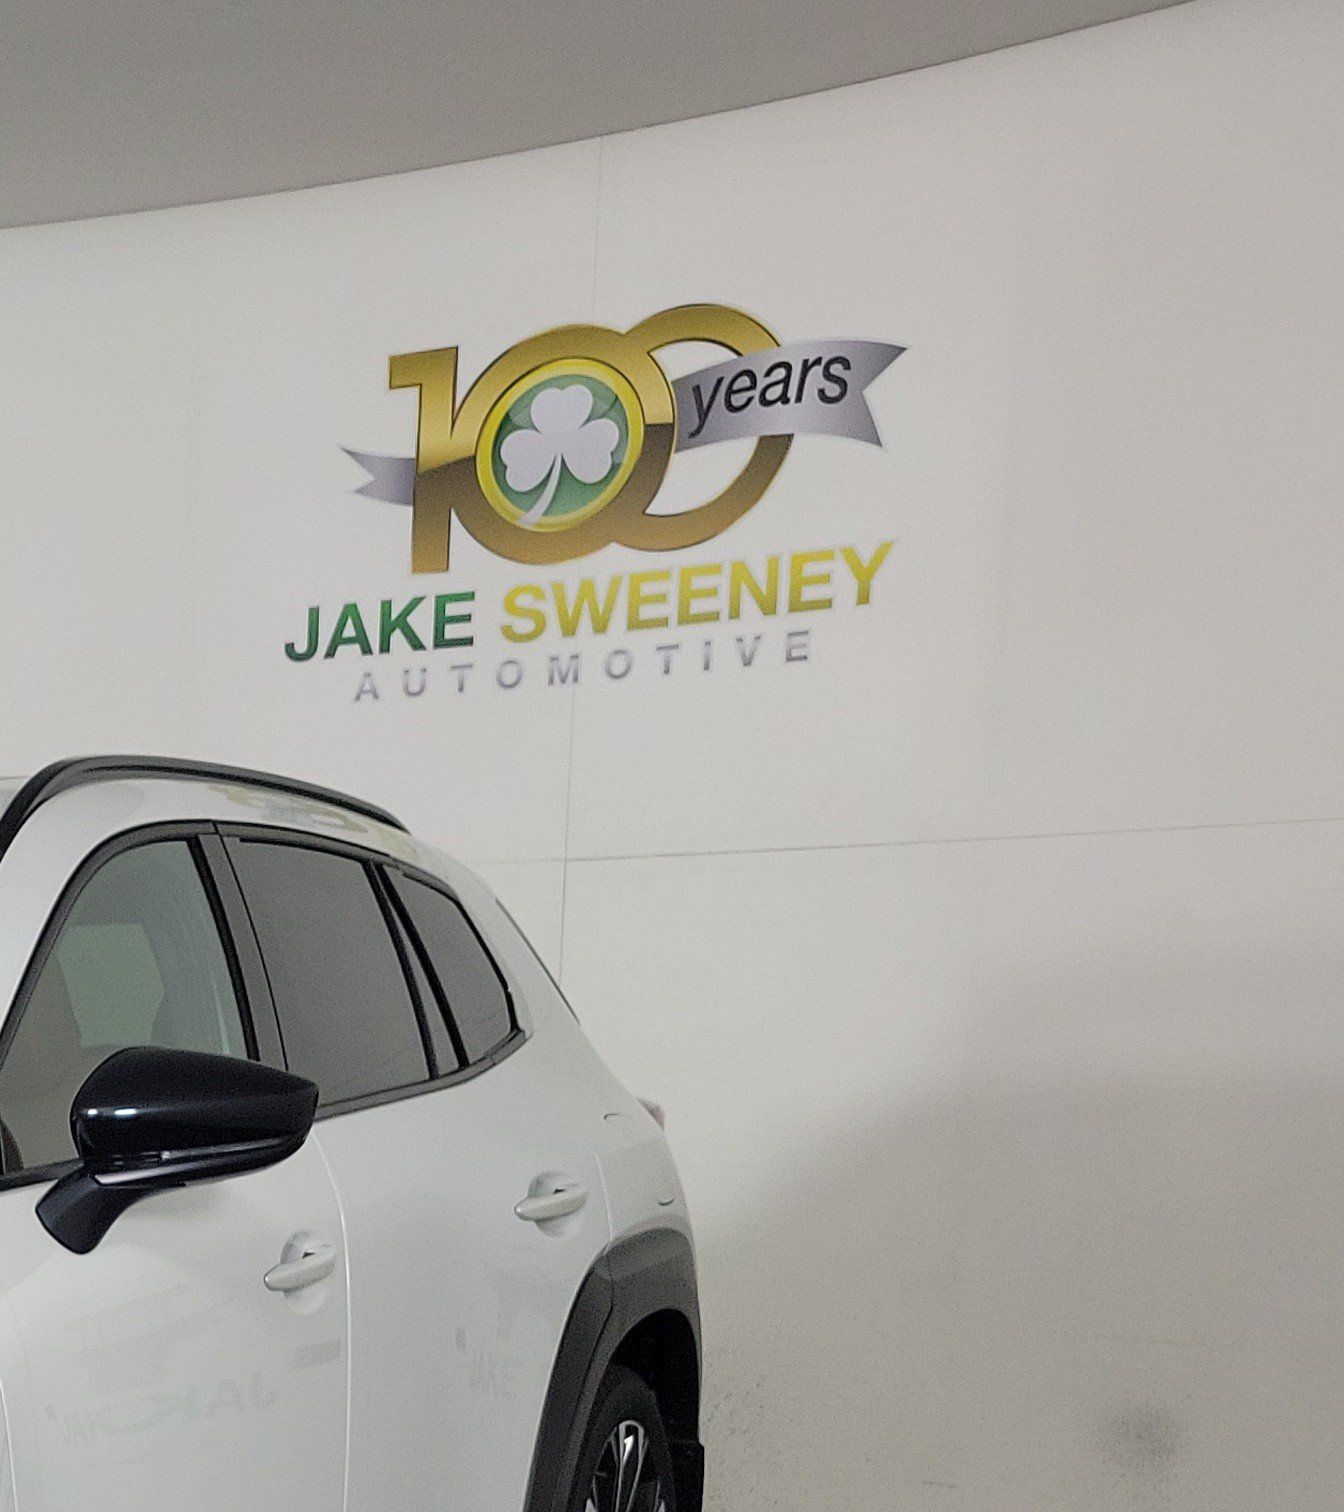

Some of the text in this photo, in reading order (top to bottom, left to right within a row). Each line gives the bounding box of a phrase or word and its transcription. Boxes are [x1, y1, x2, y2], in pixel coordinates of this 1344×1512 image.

[388, 303, 852, 573] 100 years
[284, 540, 894, 664] JAKE SWEENEY
[353, 630, 811, 702] AUTOMOTIVE
